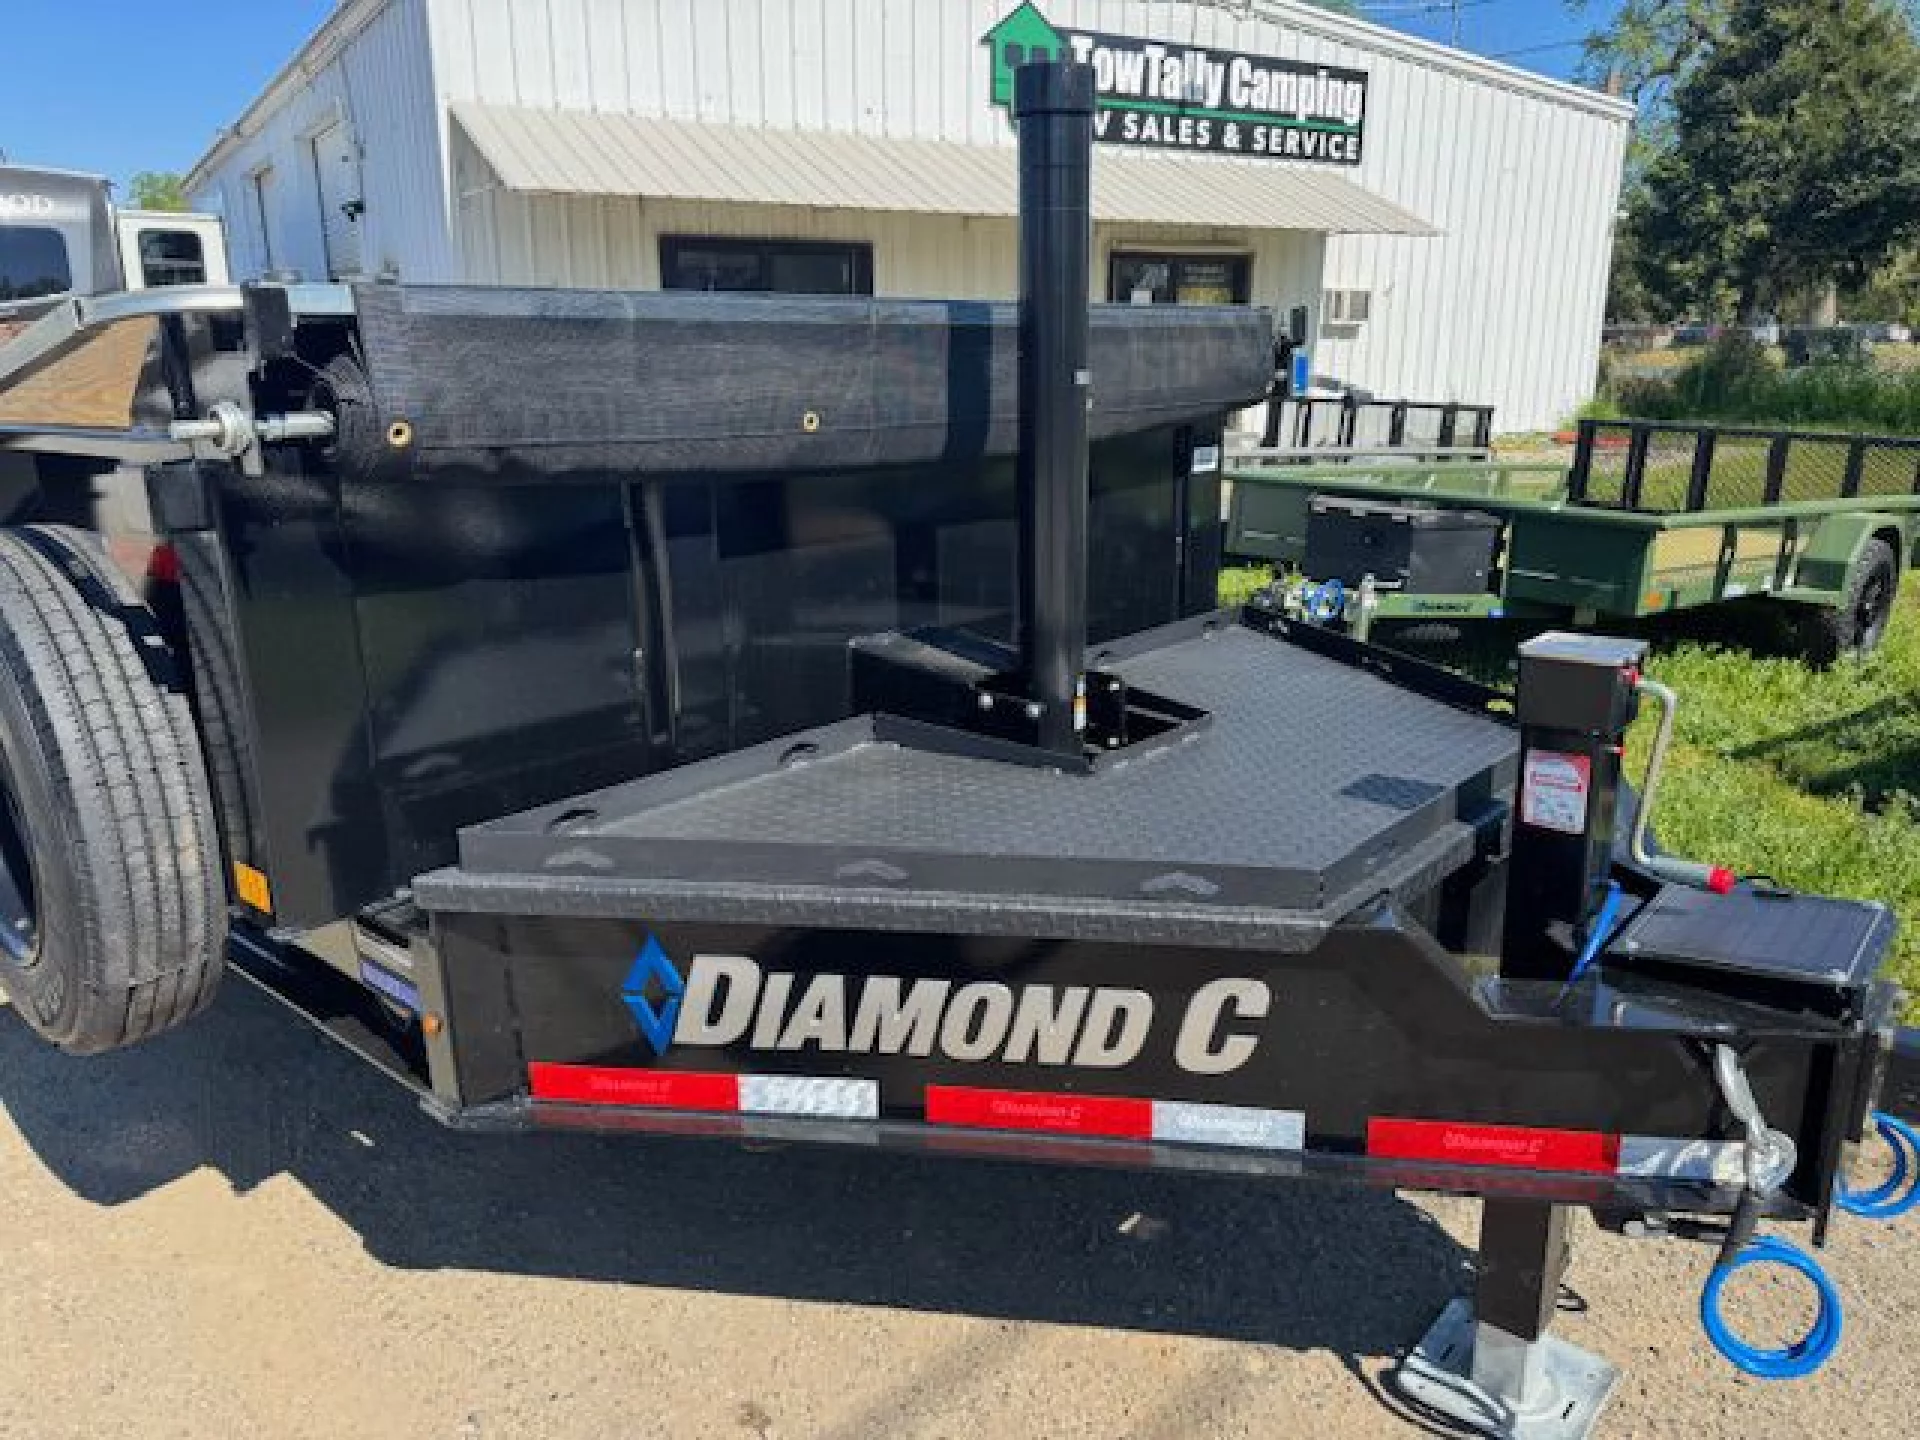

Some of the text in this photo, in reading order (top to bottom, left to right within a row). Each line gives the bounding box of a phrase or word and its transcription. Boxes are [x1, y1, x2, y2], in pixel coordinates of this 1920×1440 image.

[1229, 56, 1364, 124] Camping
[1122, 113, 1211, 146] SALES
[1224, 122, 1242, 149] &
[1253, 125, 1361, 161] SERVICE
[673, 954, 1271, 1075] DIAMOND C
